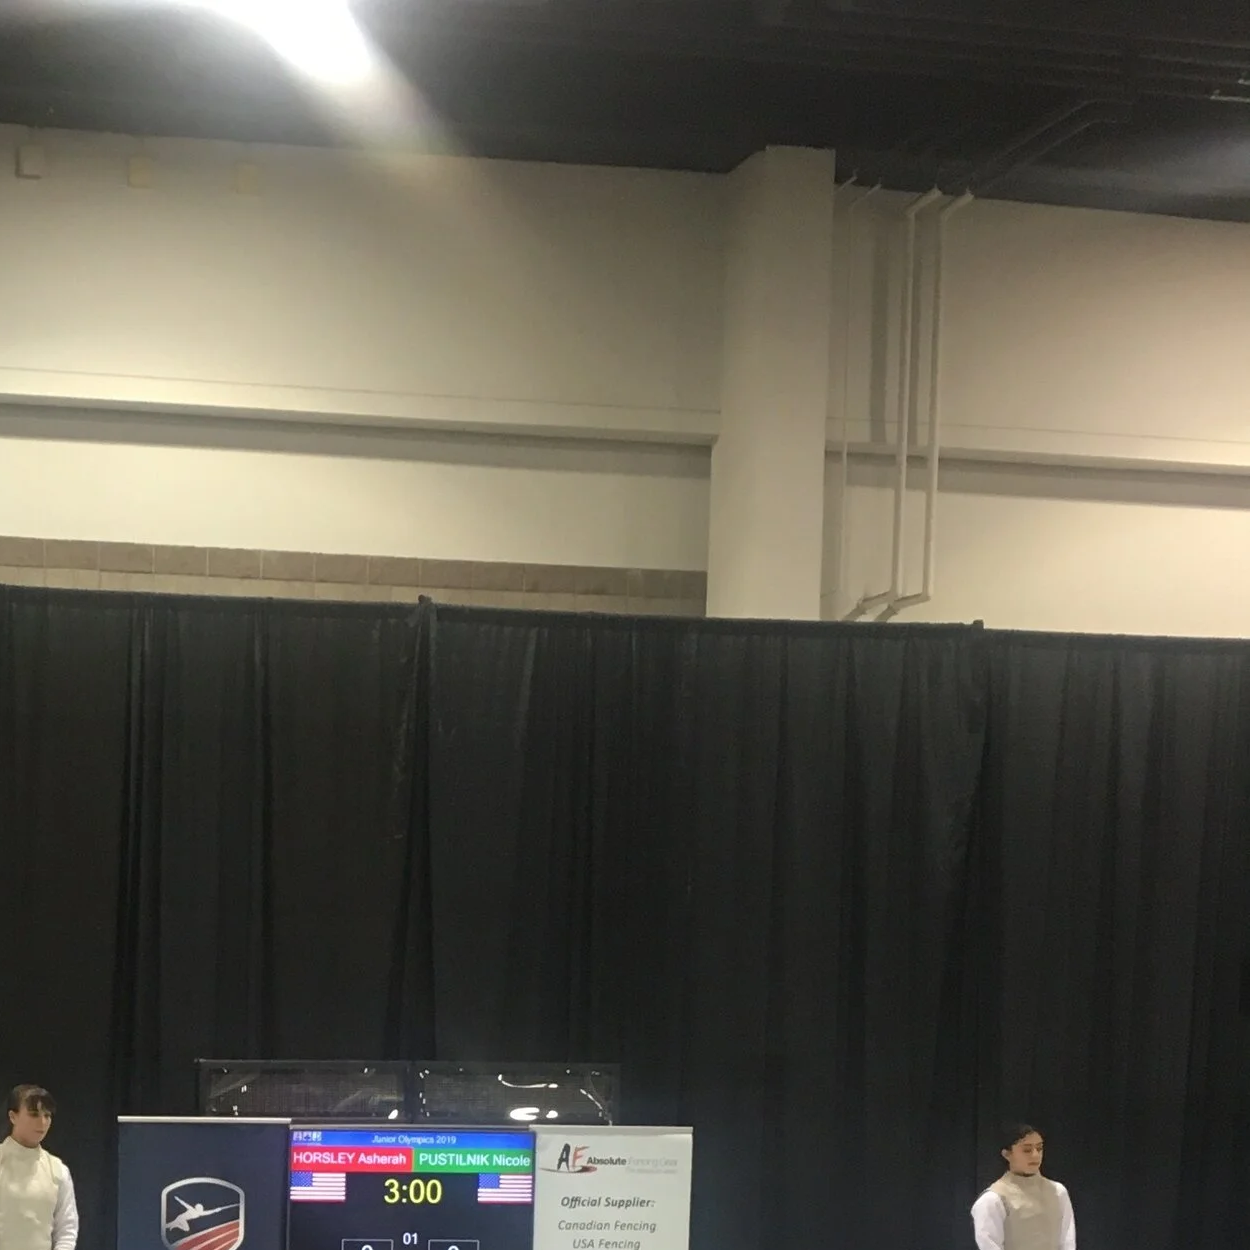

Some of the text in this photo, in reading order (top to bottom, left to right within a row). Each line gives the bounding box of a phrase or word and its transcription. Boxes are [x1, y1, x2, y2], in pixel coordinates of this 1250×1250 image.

[372, 1134, 456, 1145] Junior Olympics 2019
[293, 1152, 407, 1165] HORSLEY Asherah
[419, 1153, 531, 1166] PUSTILNIK Nicole
[587, 1156, 627, 1166] Absolute
[383, 1178, 443, 1204] 3:00
[561, 1196, 656, 1210] Official Supplier:
[558, 1220, 657, 1233] Canadian Fencing
[403, 1232, 419, 1245] 01
[572, 1239, 641, 1250] USA Fencing
